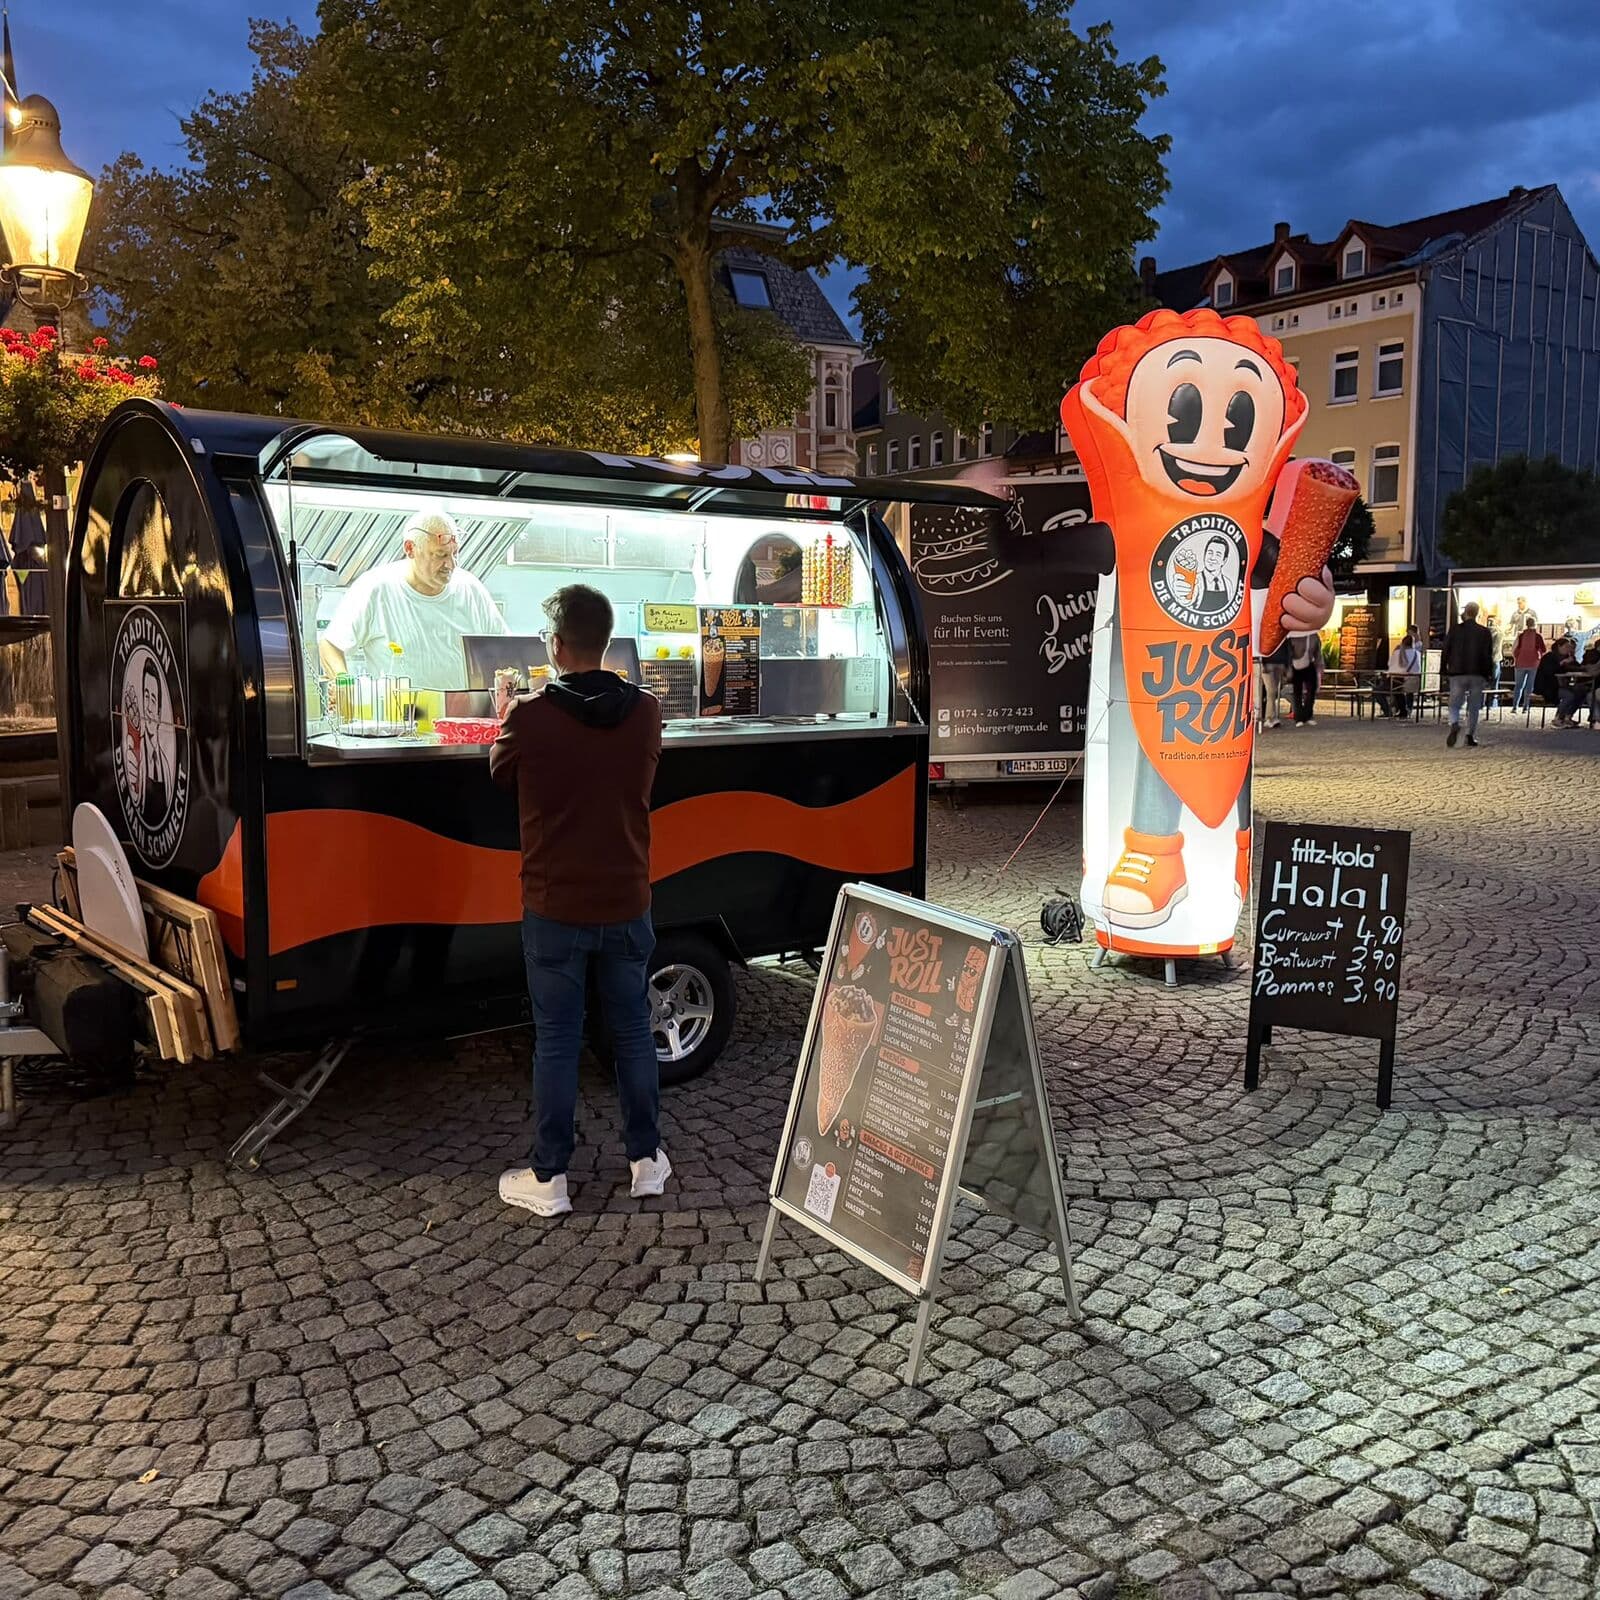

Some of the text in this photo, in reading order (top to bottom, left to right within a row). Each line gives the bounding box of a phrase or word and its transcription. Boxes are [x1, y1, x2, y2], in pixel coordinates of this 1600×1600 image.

[1171, 517, 1243, 543] TRADITION
[1153, 579, 1245, 626] DIE MAN SCHMECKT
[941, 614, 972, 623] Buchen
[974, 614, 986, 622] Sie
[934, 626, 1009, 638] für Ihr Event:
[118, 617, 171, 674] TRADITION
[1142, 630, 1250, 696] JUST
[954, 709, 977, 718] 0174
[987, 708, 998, 717] 26
[1001, 708, 1013, 716] 72
[1016, 707, 1033, 716] 423
[954, 722, 1048, 736] juicyburger@gmx.de
[1013, 760, 1066, 771] AH JB 103
[1211, 752, 1224, 760] man
[115, 746, 187, 859] DIE MAN SCHMECKT
[1292, 838, 1375, 868] fritz-kola
[1271, 861, 1388, 911] Halal
[1357, 914, 1401, 947] 4,90
[886, 927, 942, 962] JUST
[1259, 943, 1396, 973] Bratwurst 3,90
[890, 956, 942, 992] ROLL
[1255, 969, 1396, 1003] Pommes 3,90
[895, 994, 916, 1008] ROLLS
[888, 1014, 907, 1027] CHICKEN
[931, 1032, 943, 1042] ROLL
[890, 1004, 902, 1014] BEEF
[926, 1019, 937, 1028] ROLL
[886, 1024, 918, 1042] CURRYWURST
[919, 1038, 932, 1048] ROLL
[901, 1041, 913, 1051] ROLL
[878, 1060, 889, 1070] BEEF
[874, 1077, 893, 1091] CHICKEN
[870, 1094, 901, 1115] CURRYWURST
[903, 1110, 914, 1120] ROLL
[882, 1119, 893, 1130] ROLL
[863, 1133, 888, 1152] SNACKS
[888, 1146, 893, 1155] &
[895, 1148, 930, 1174] GETRÄNKE
[855, 1159, 882, 1179] BRATWURST
[849, 1184, 862, 1196] FRITZ
[851, 1174, 869, 1189] DOLLAR
[870, 1184, 884, 1198] Chips
[845, 1200, 864, 1217] WASSER
